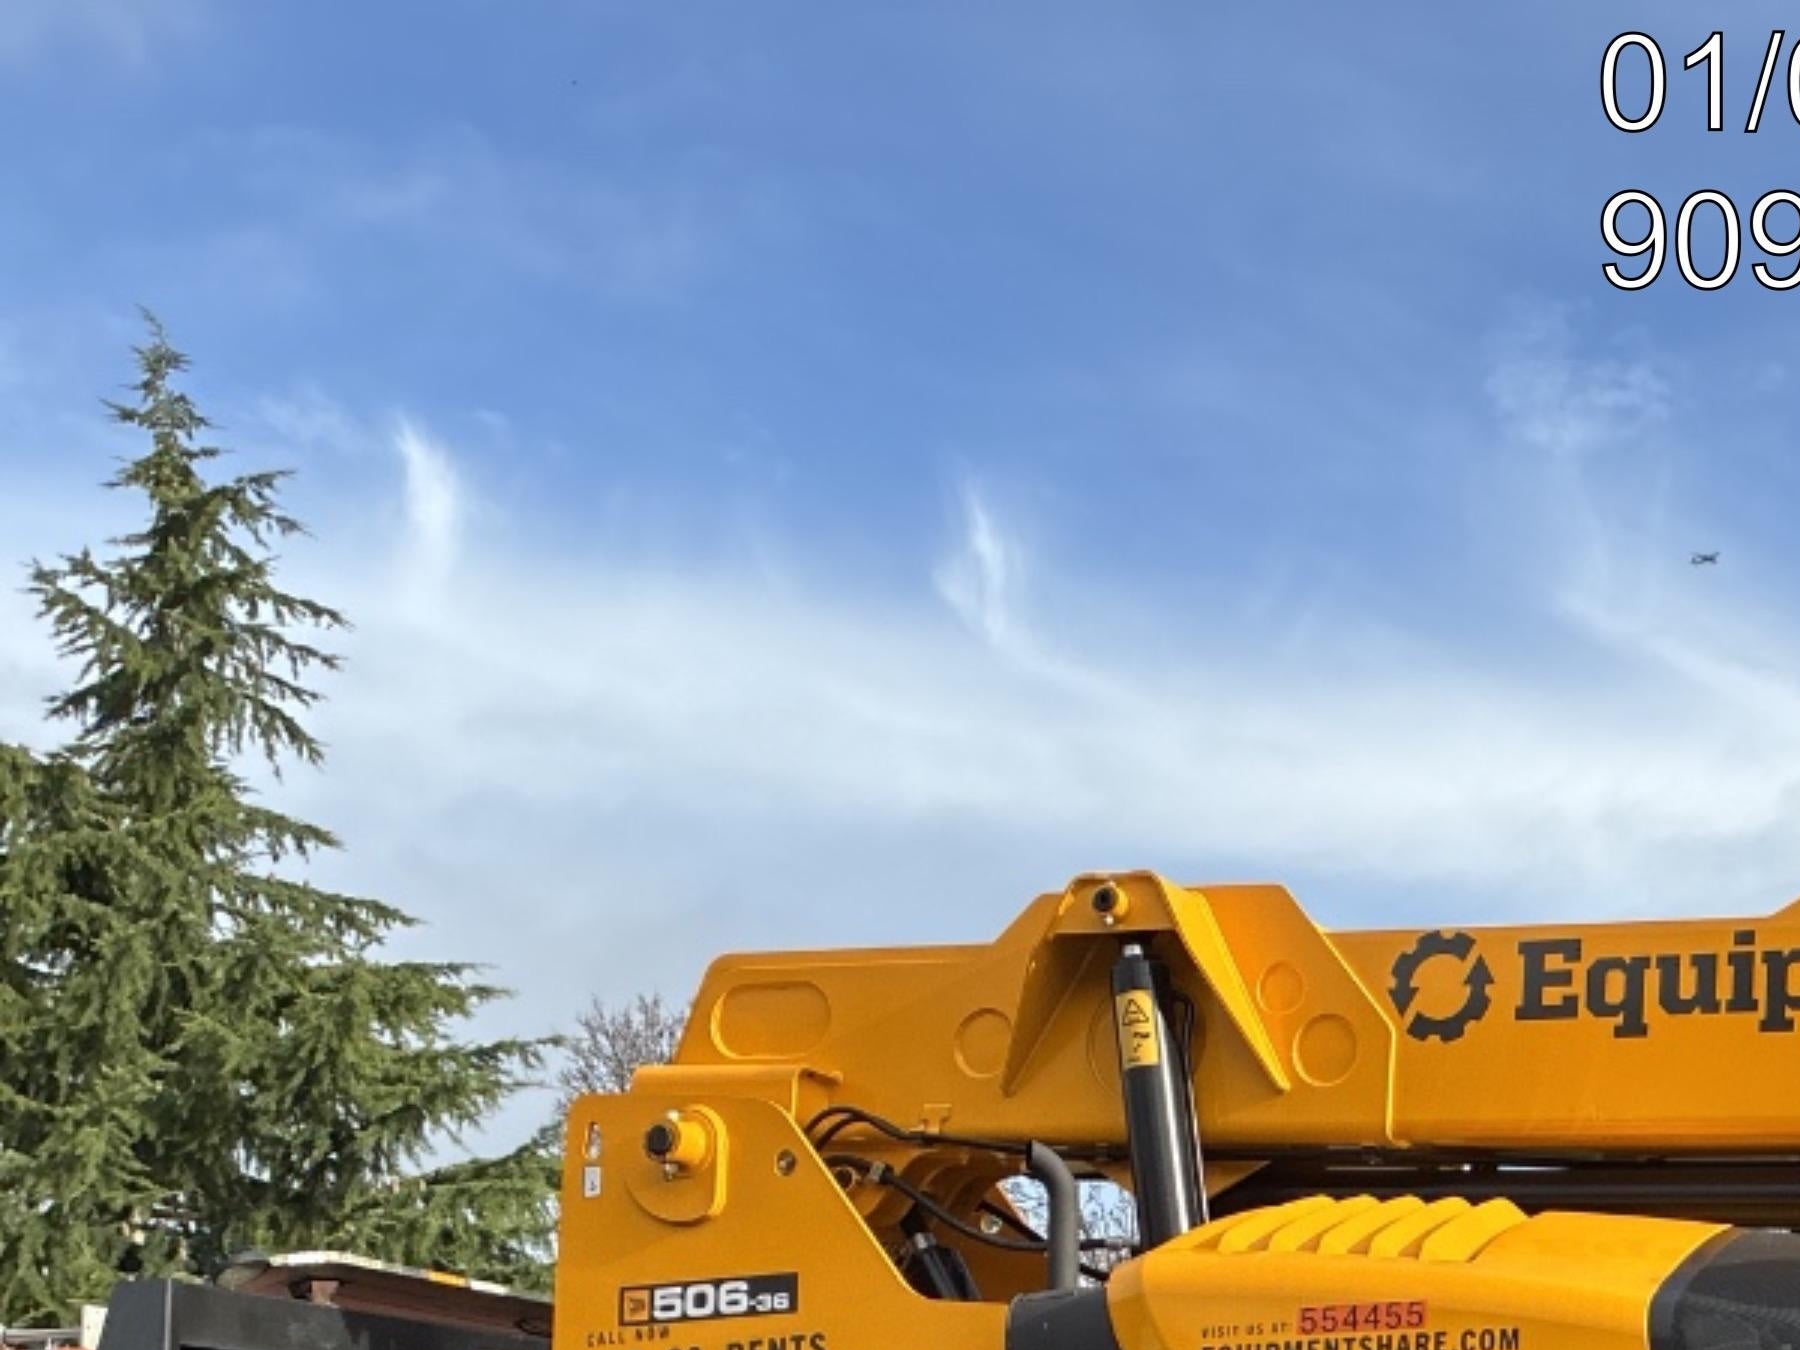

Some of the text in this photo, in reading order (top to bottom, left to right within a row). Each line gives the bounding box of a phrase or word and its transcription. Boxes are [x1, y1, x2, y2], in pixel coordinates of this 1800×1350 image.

[653, 1280, 790, 1320] 506-36
[1300, 1302, 1424, 1336] 554455
[587, 1325, 671, 1348] CALL NOW
